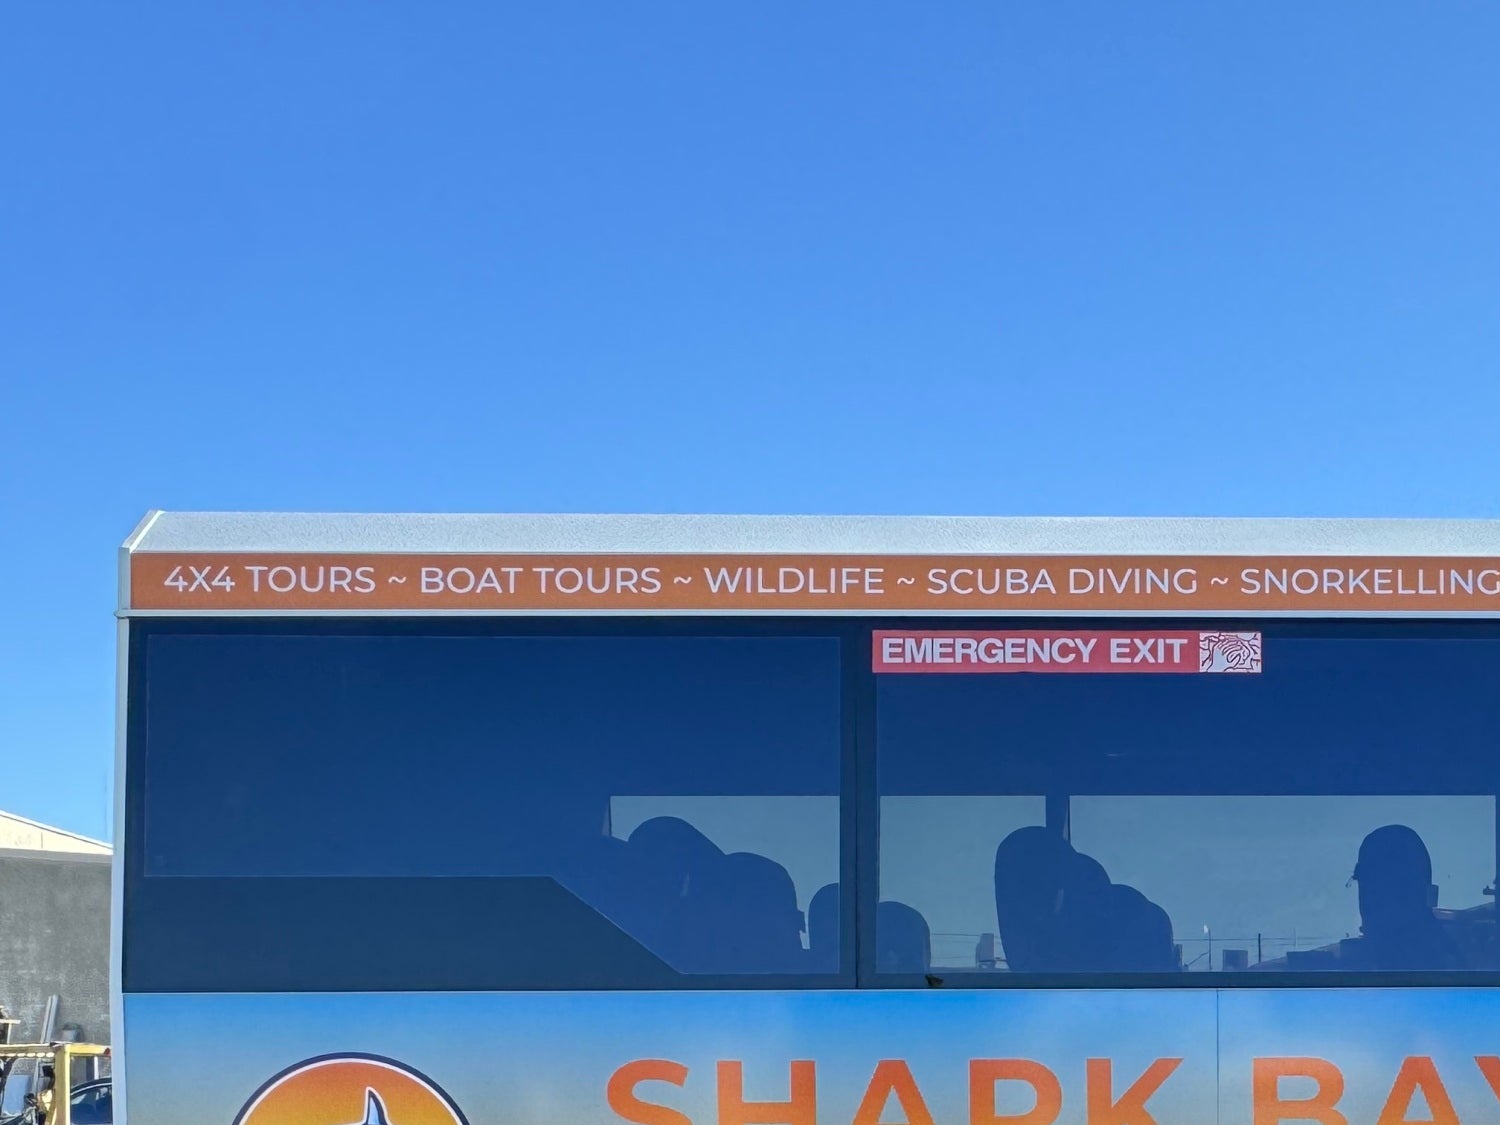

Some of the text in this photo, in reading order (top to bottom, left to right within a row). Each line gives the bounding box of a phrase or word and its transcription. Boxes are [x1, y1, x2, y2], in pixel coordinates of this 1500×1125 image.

[163, 565, 236, 593] 4X4
[244, 565, 376, 594] TOURS
[420, 566, 524, 594] BOAT
[532, 567, 662, 594] TOURS
[703, 567, 885, 594] WILDLIFE
[927, 568, 1057, 595] SCUBA
[1069, 567, 1198, 595] DIVING
[1240, 568, 1500, 596] SNORKELLING
[882, 637, 1188, 664] EMERGENCY EXIT
